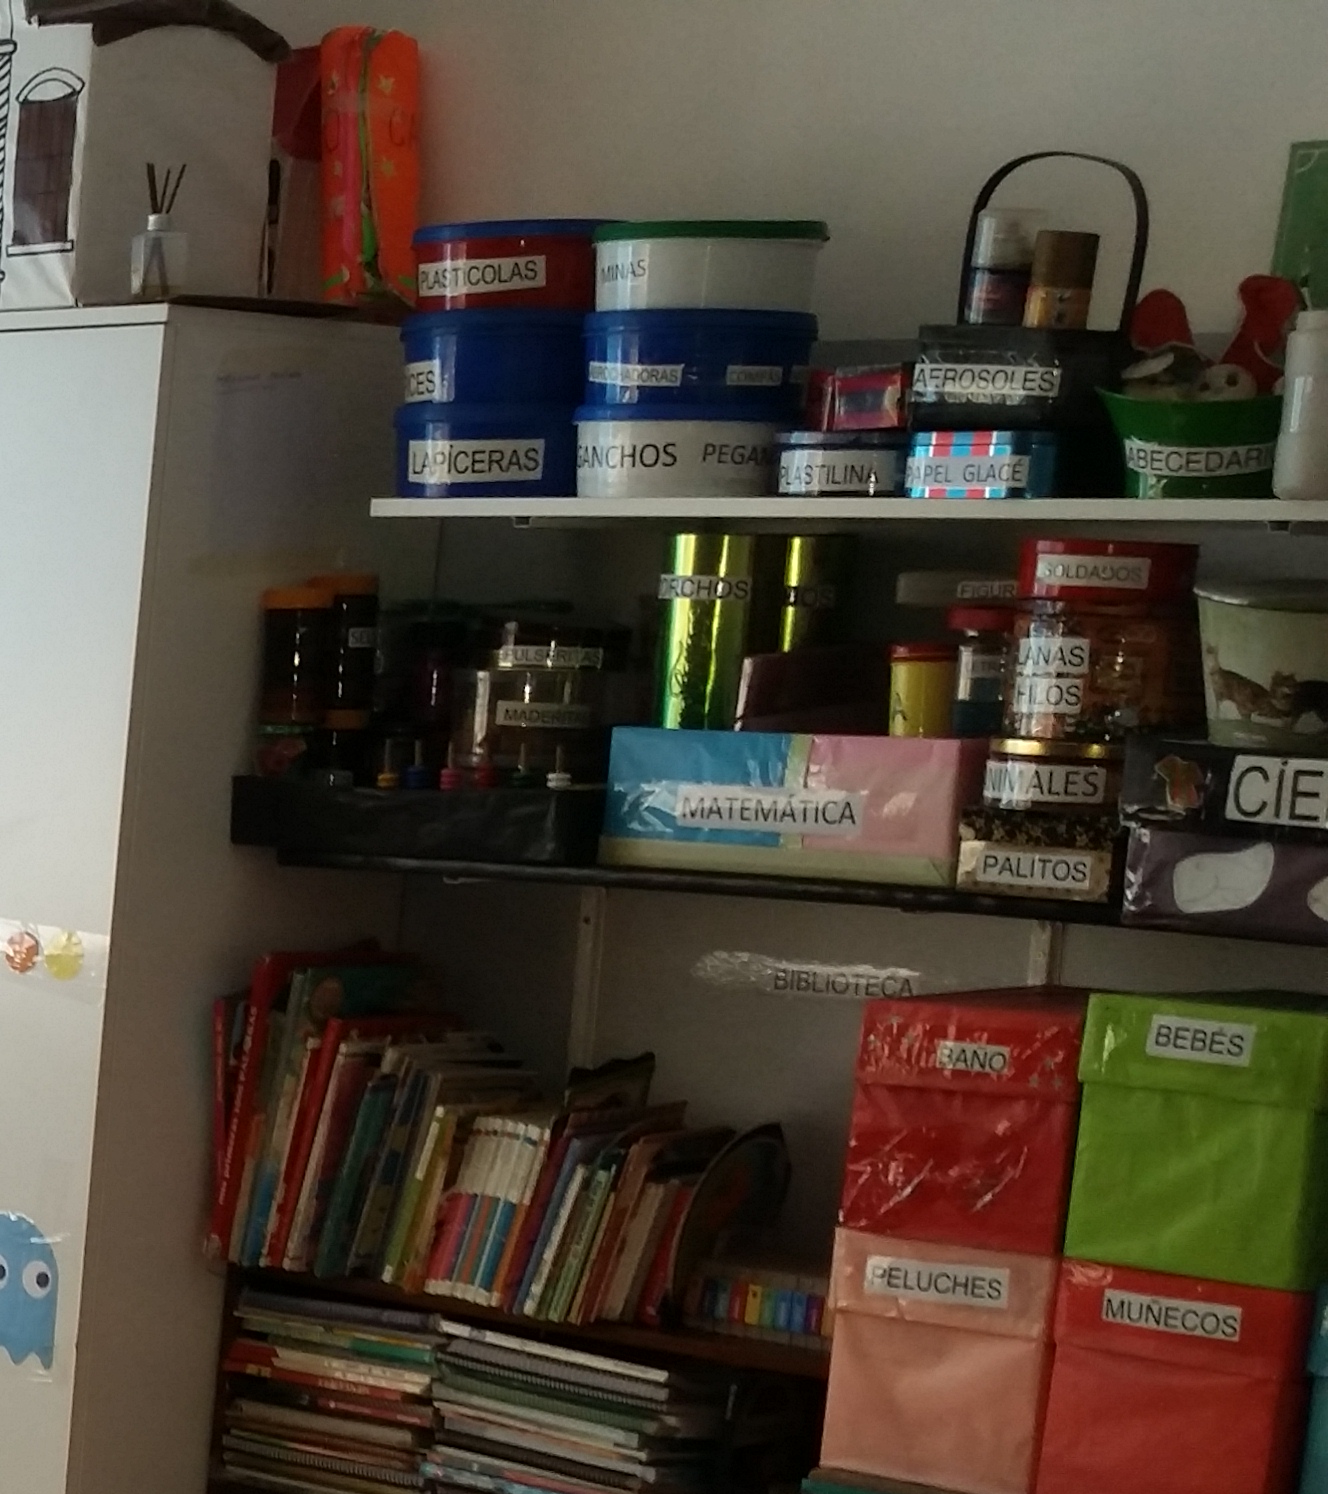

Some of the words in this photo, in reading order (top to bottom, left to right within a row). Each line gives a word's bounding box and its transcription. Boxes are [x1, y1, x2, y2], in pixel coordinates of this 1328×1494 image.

[601, 259, 647, 283] MINAS
[915, 367, 1056, 394] AEROSOLES
[780, 464, 880, 486] PLASTILINA
[906, 462, 952, 484] PAPEL
[962, 458, 1023, 483] GLACÉ
[1045, 562, 1144, 582] SOLDADOS
[681, 794, 857, 826] MATEMÁTICA
[983, 854, 1088, 884] PALITOS
[773, 968, 914, 998] BIBLIOTECA
[1155, 1023, 1245, 1057] BEBÉS
[870, 1265, 1002, 1301] PELUCHES
[1104, 1296, 1239, 1338] MUÑECOS
